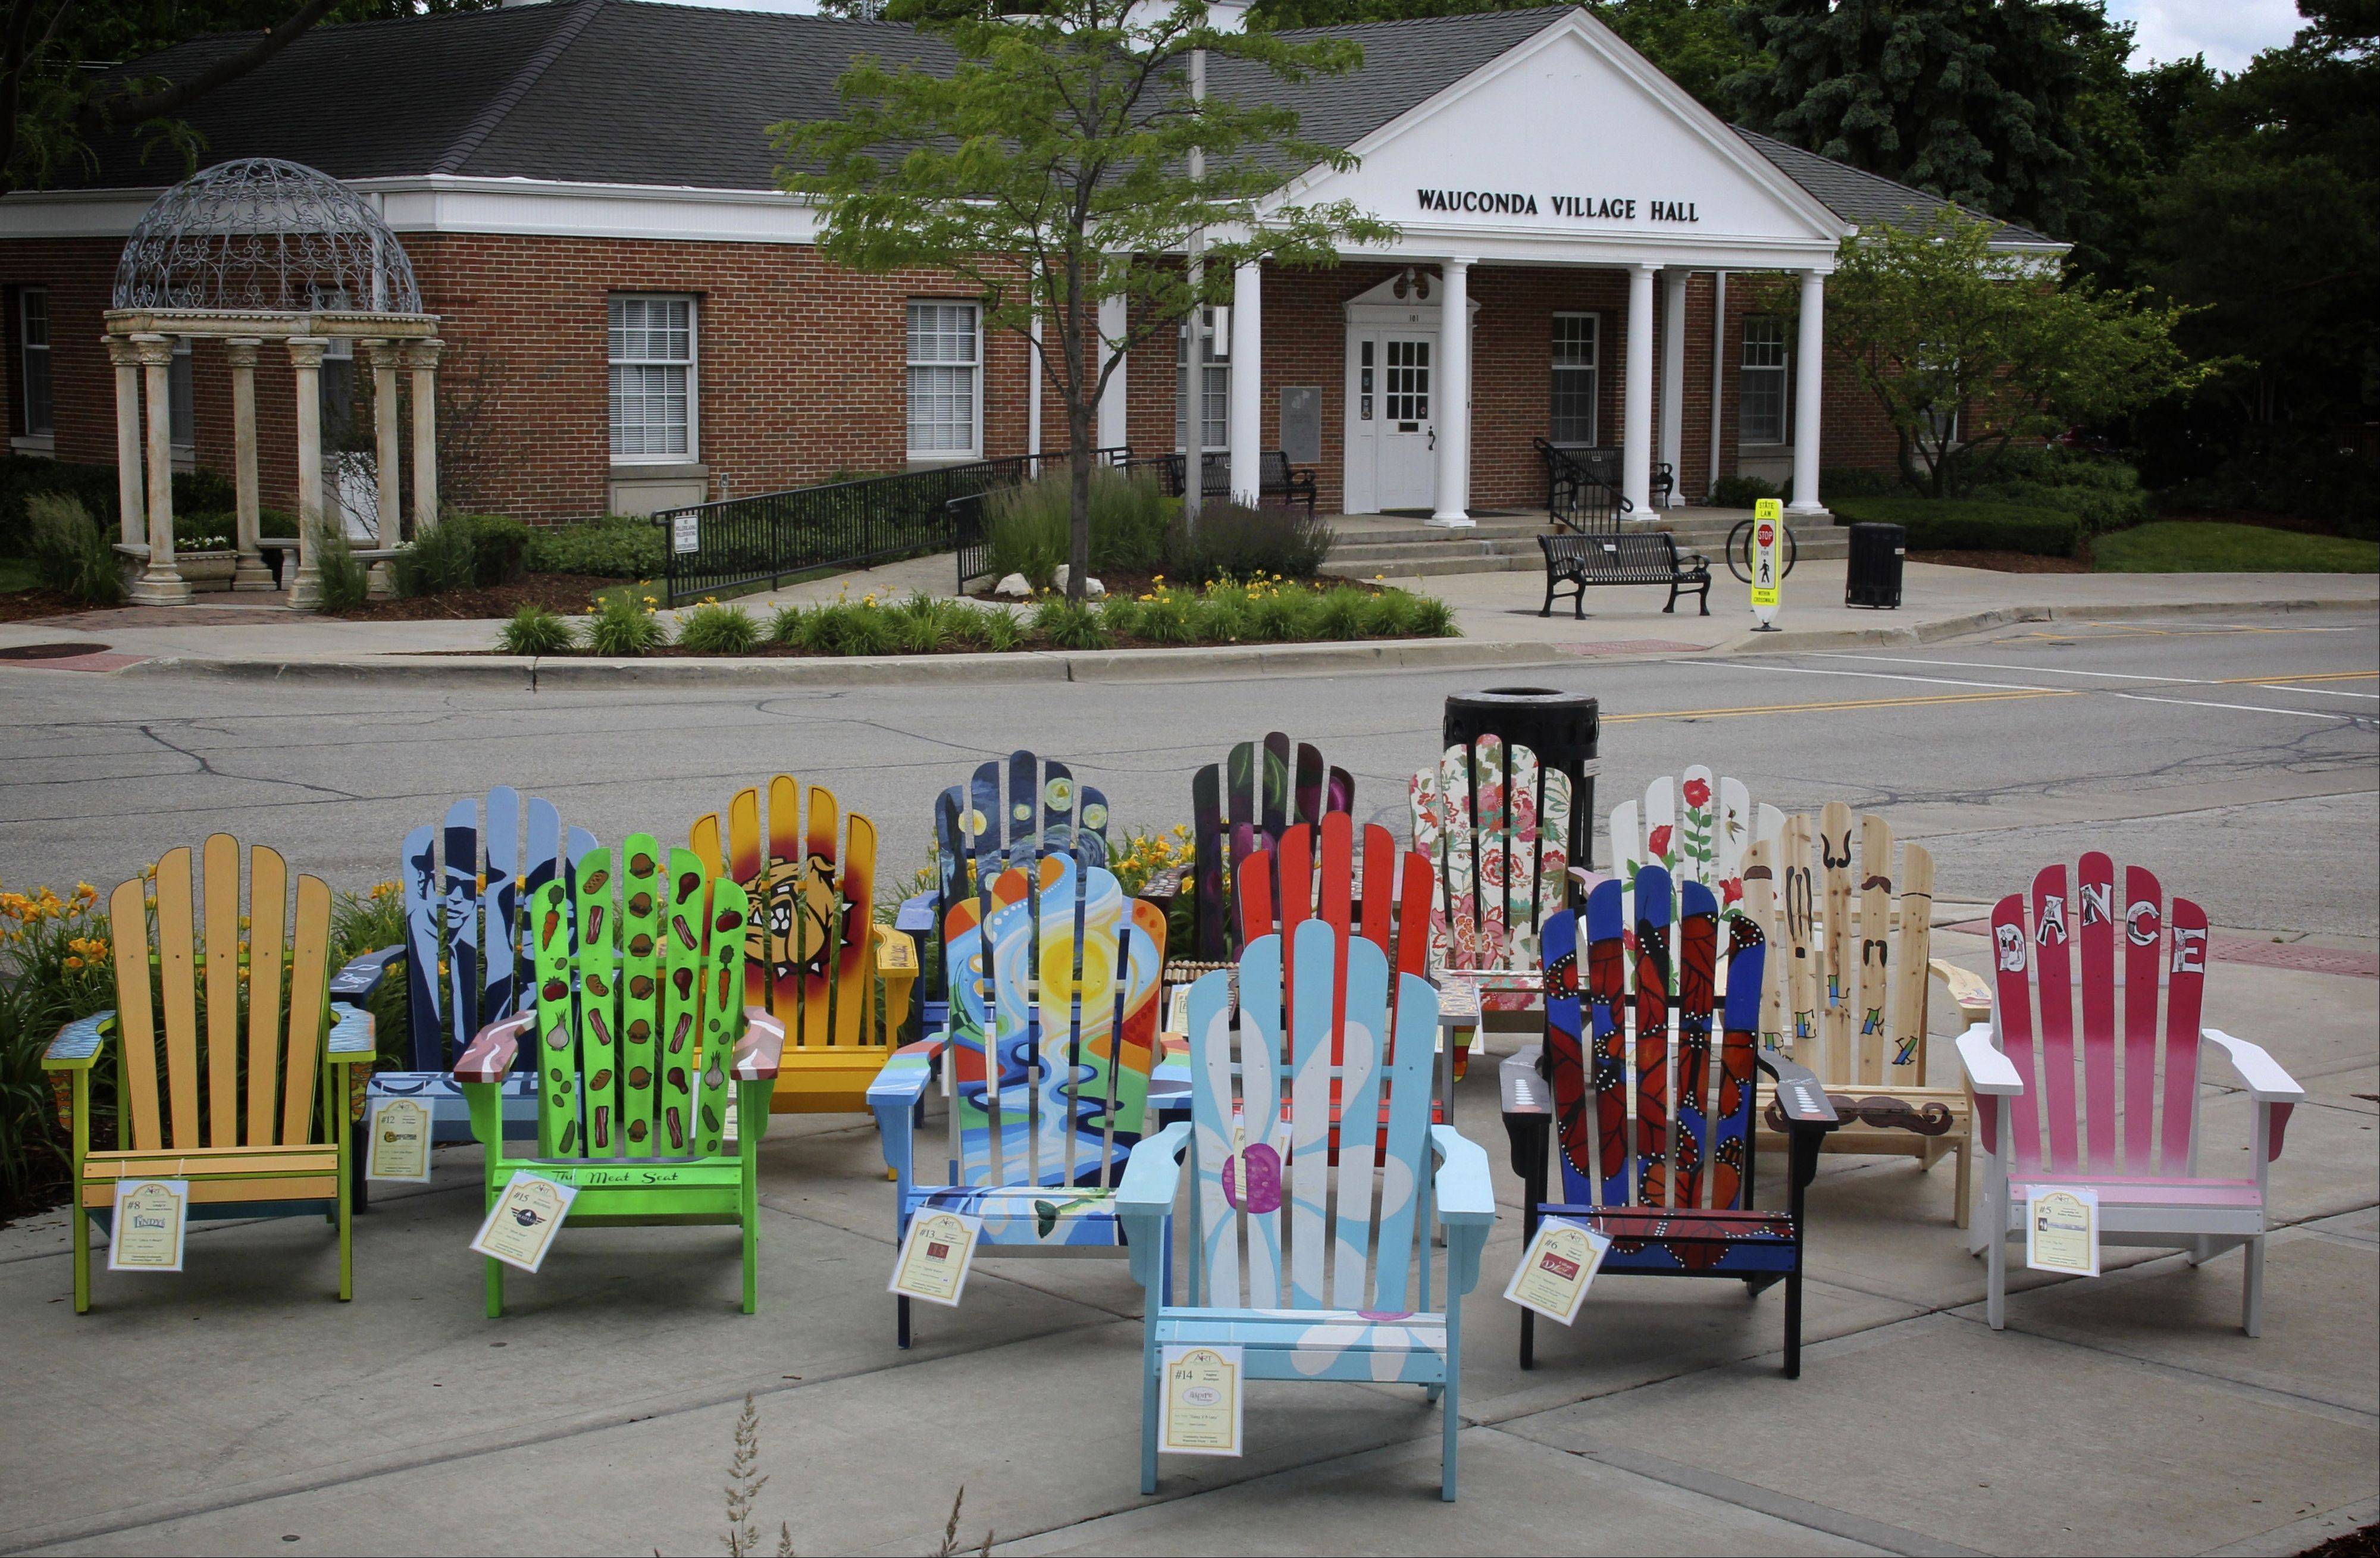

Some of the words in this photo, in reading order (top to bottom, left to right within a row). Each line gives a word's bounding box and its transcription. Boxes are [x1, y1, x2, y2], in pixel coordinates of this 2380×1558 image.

[1418, 189, 1538, 215] WAUCONDA
[1551, 196, 1636, 220] VILLAGE
[1651, 201, 1699, 222] HALL
[1758, 531, 1773, 540] STOP
[381, 1115, 395, 1124] #12
[586, 1172, 628, 1184] Meat
[641, 1171, 678, 1184] Seat
[513, 1192, 530, 1202] #15
[127, 1201, 140, 1210] #8
[2039, 1205, 2052, 1215] #5
[919, 1228, 935, 1239] #13
[1545, 1239, 1558, 1250] #6
[1175, 1369, 1194, 1380] #14
